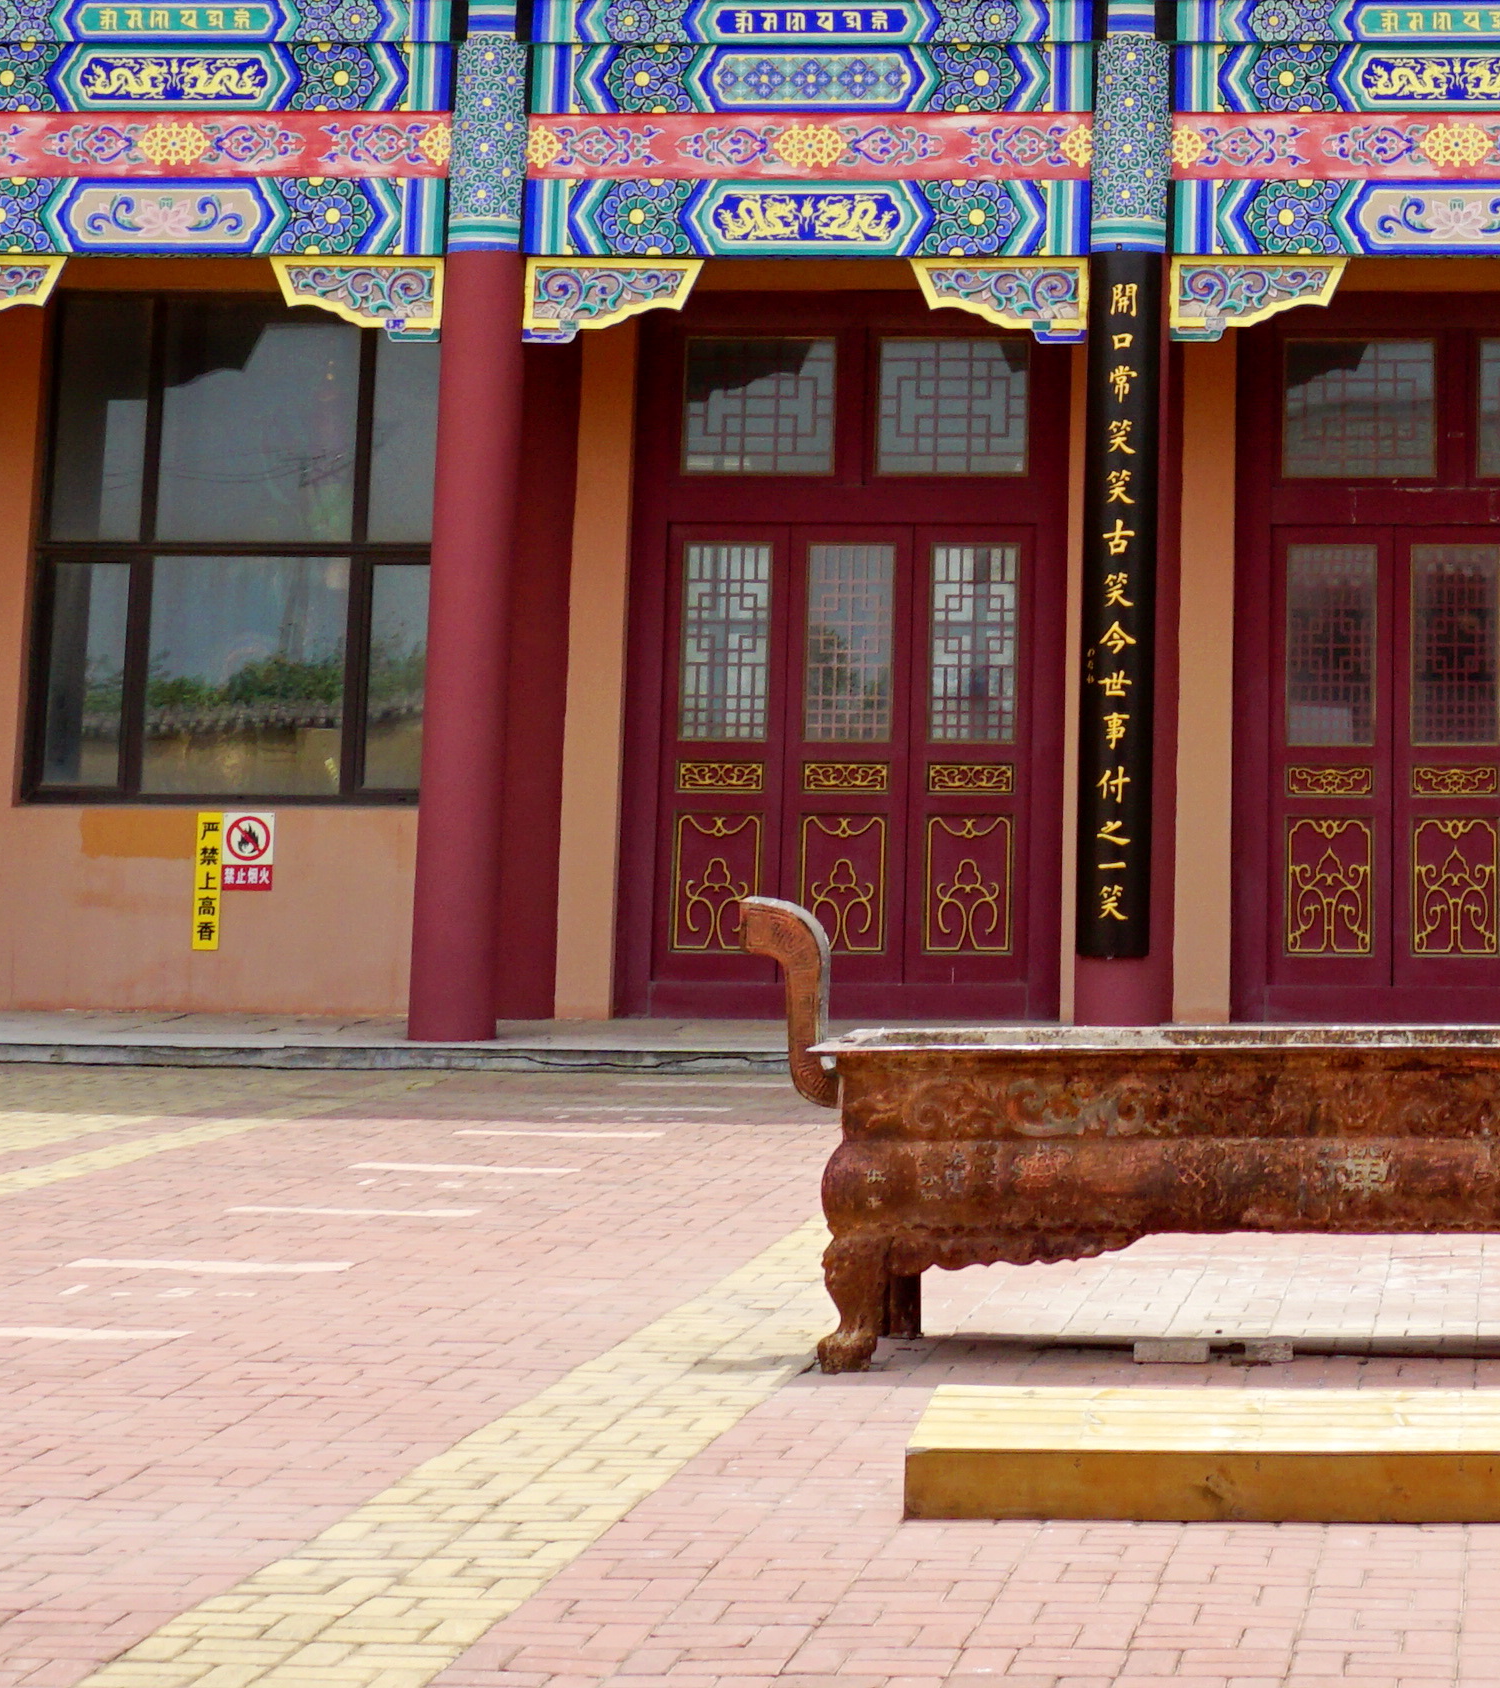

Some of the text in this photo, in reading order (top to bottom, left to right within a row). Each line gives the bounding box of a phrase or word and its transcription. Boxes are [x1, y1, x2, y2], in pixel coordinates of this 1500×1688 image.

[1095, 283, 1138, 922] 開口常笑笑古笑今世事付之一笑
[196, 821, 220, 942] 严禁上高香
[223, 867, 270, 885] 禁止烟火
